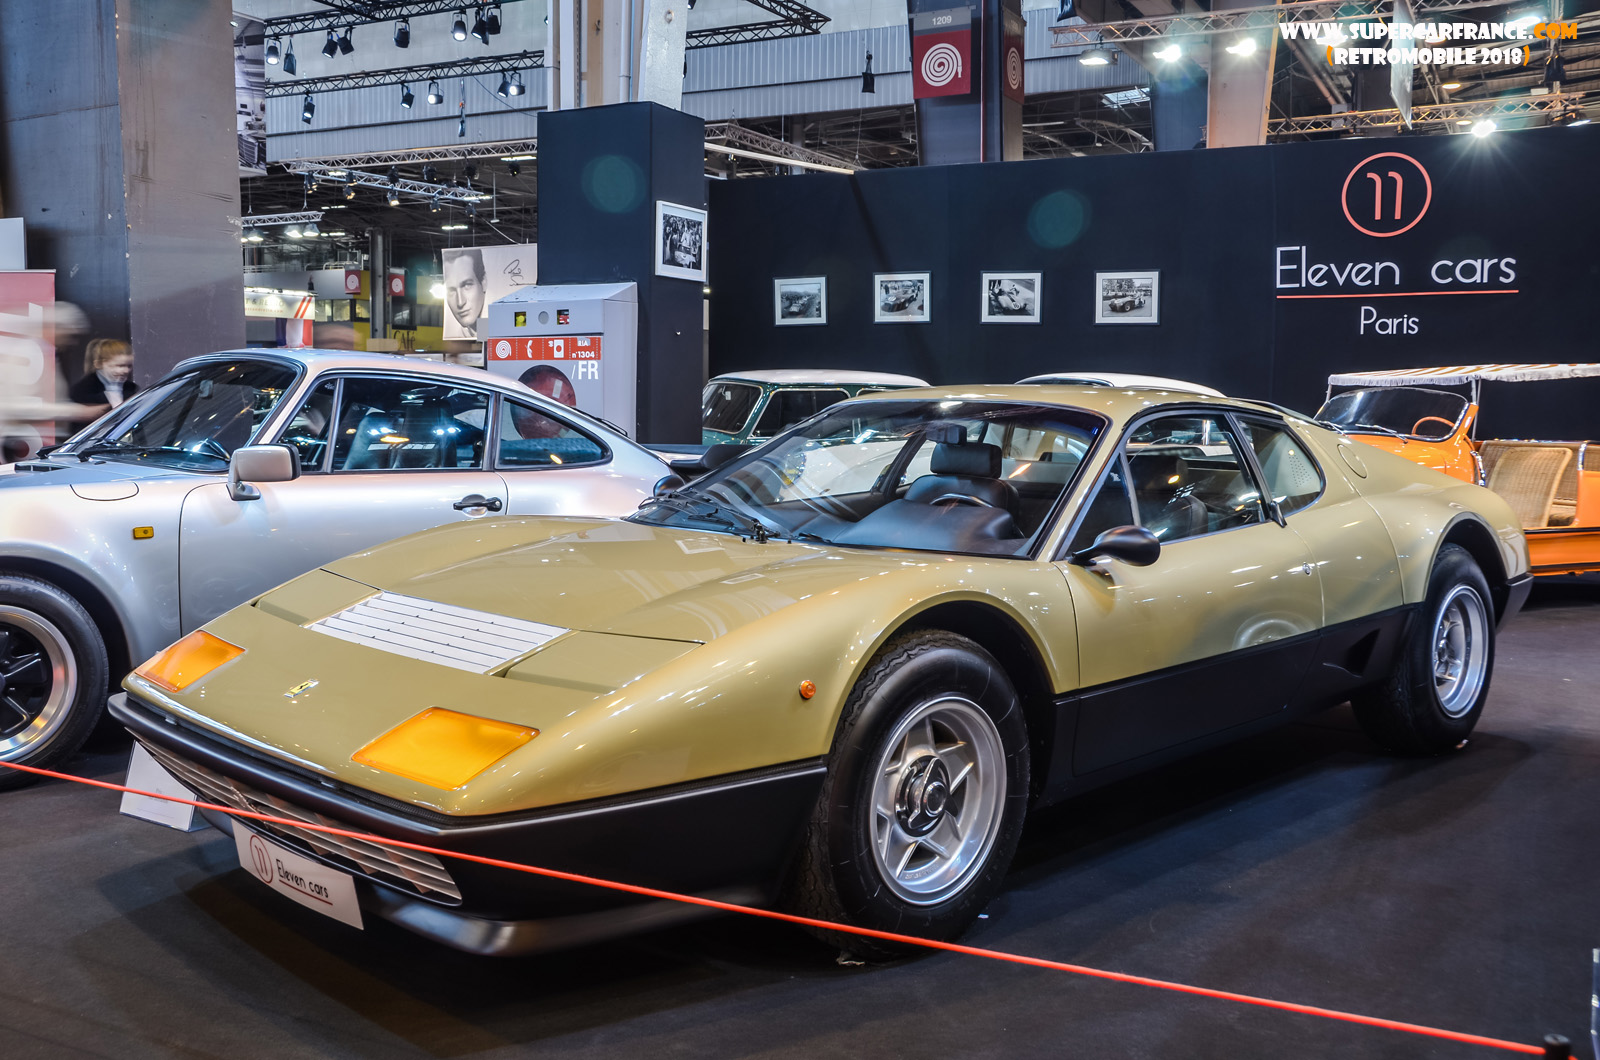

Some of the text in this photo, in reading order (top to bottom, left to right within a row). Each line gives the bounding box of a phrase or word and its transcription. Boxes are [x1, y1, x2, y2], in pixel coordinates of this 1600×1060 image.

[932, 15, 952, 25] 1209
[1276, 246, 1517, 289] Eleven cars
[1360, 306, 1419, 335] Paris
[276, 858, 329, 898] Eleven cars
